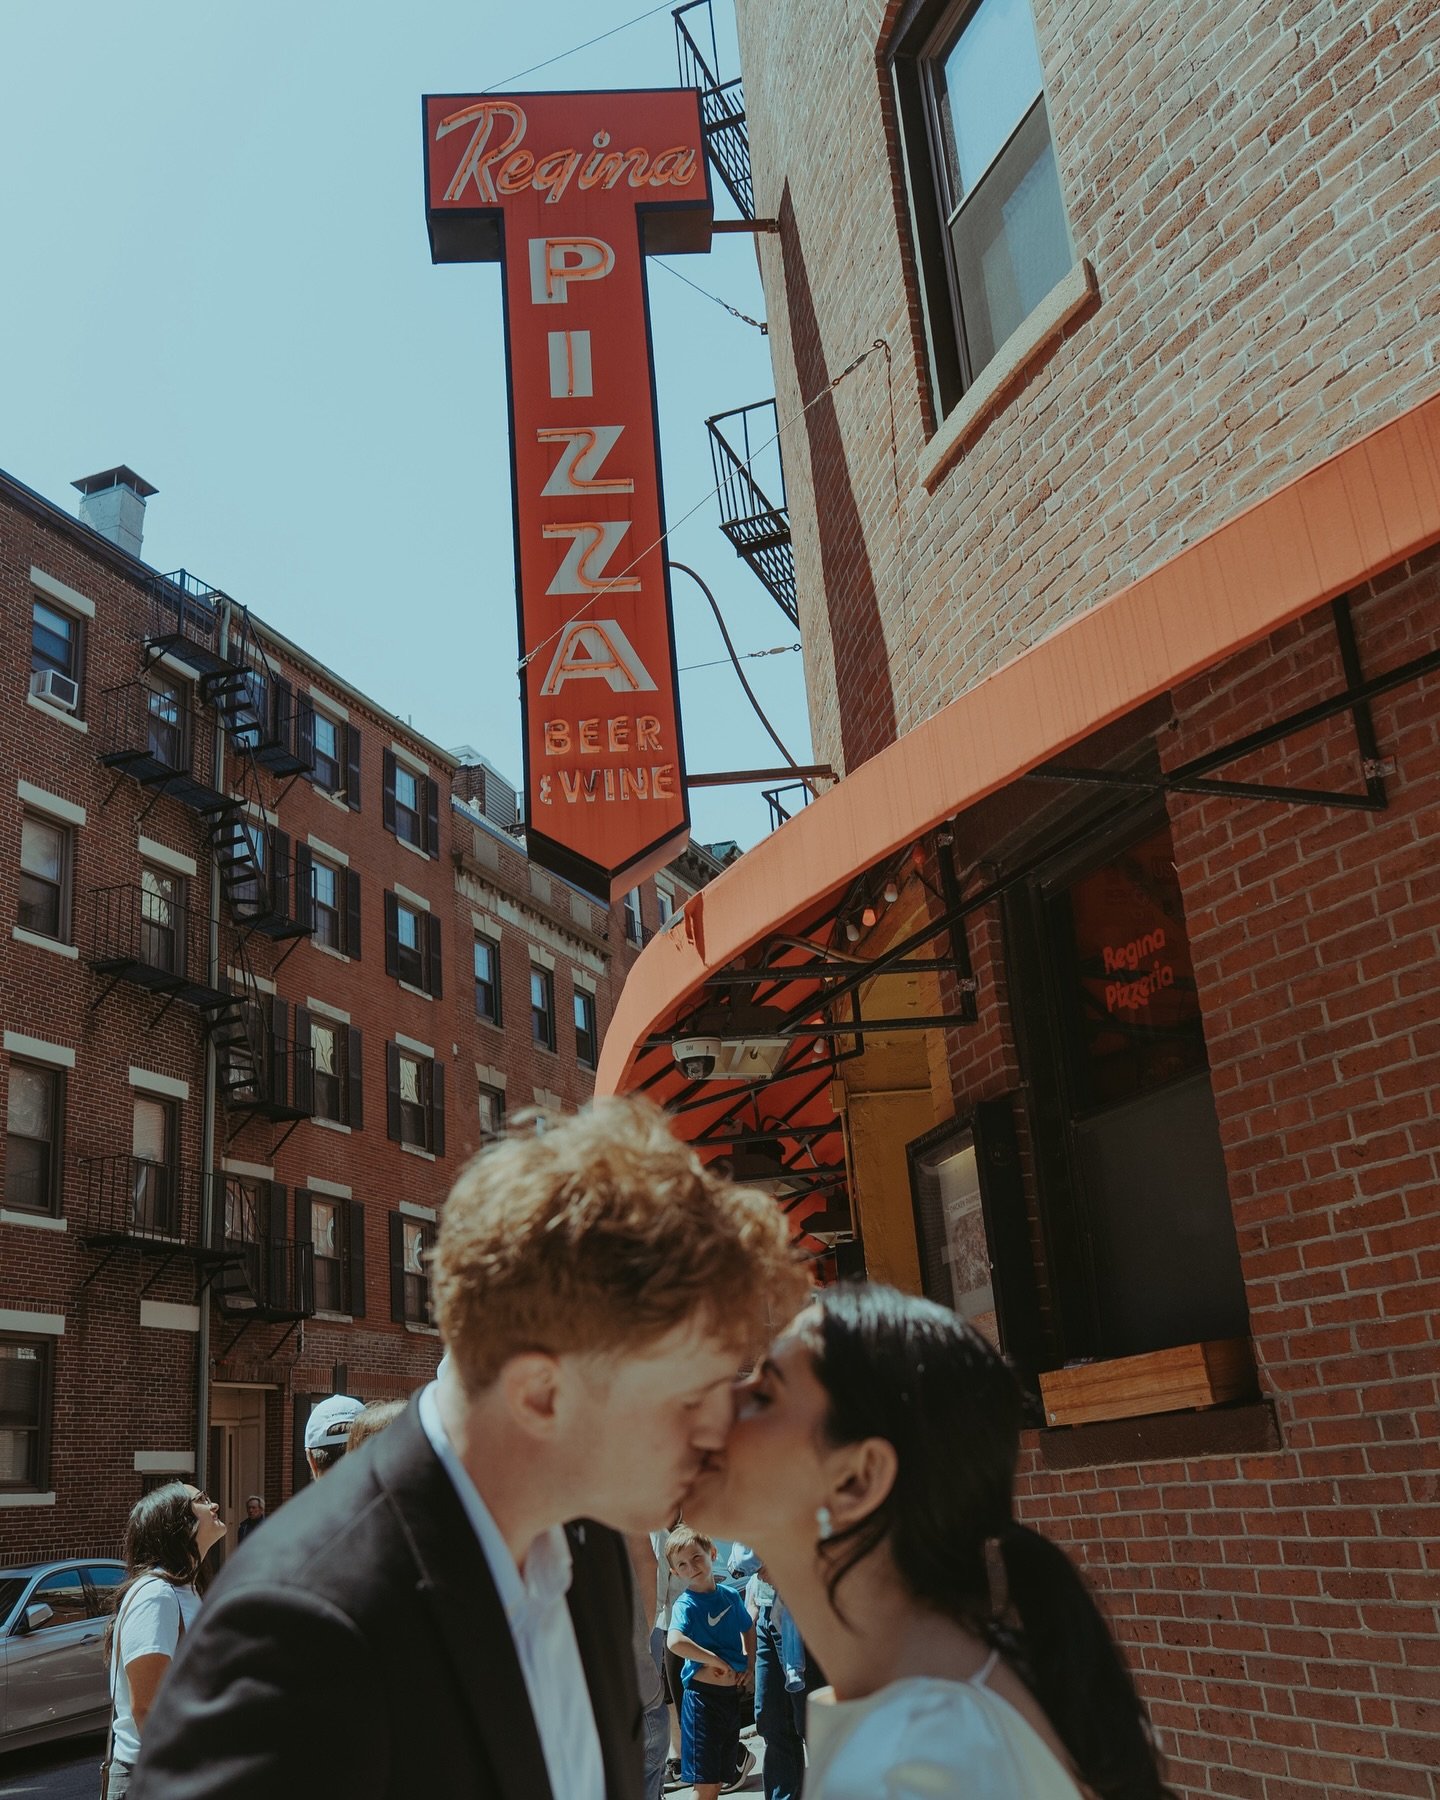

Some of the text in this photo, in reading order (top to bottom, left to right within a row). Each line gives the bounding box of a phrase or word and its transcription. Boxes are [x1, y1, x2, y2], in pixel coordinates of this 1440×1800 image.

[435, 101, 697, 204] Regina
[528, 236, 659, 696] PIZZA
[543, 715, 663, 756] BEER
[1102, 928, 1166, 975] Regina
[1104, 960, 1174, 1013] Pizzeria
